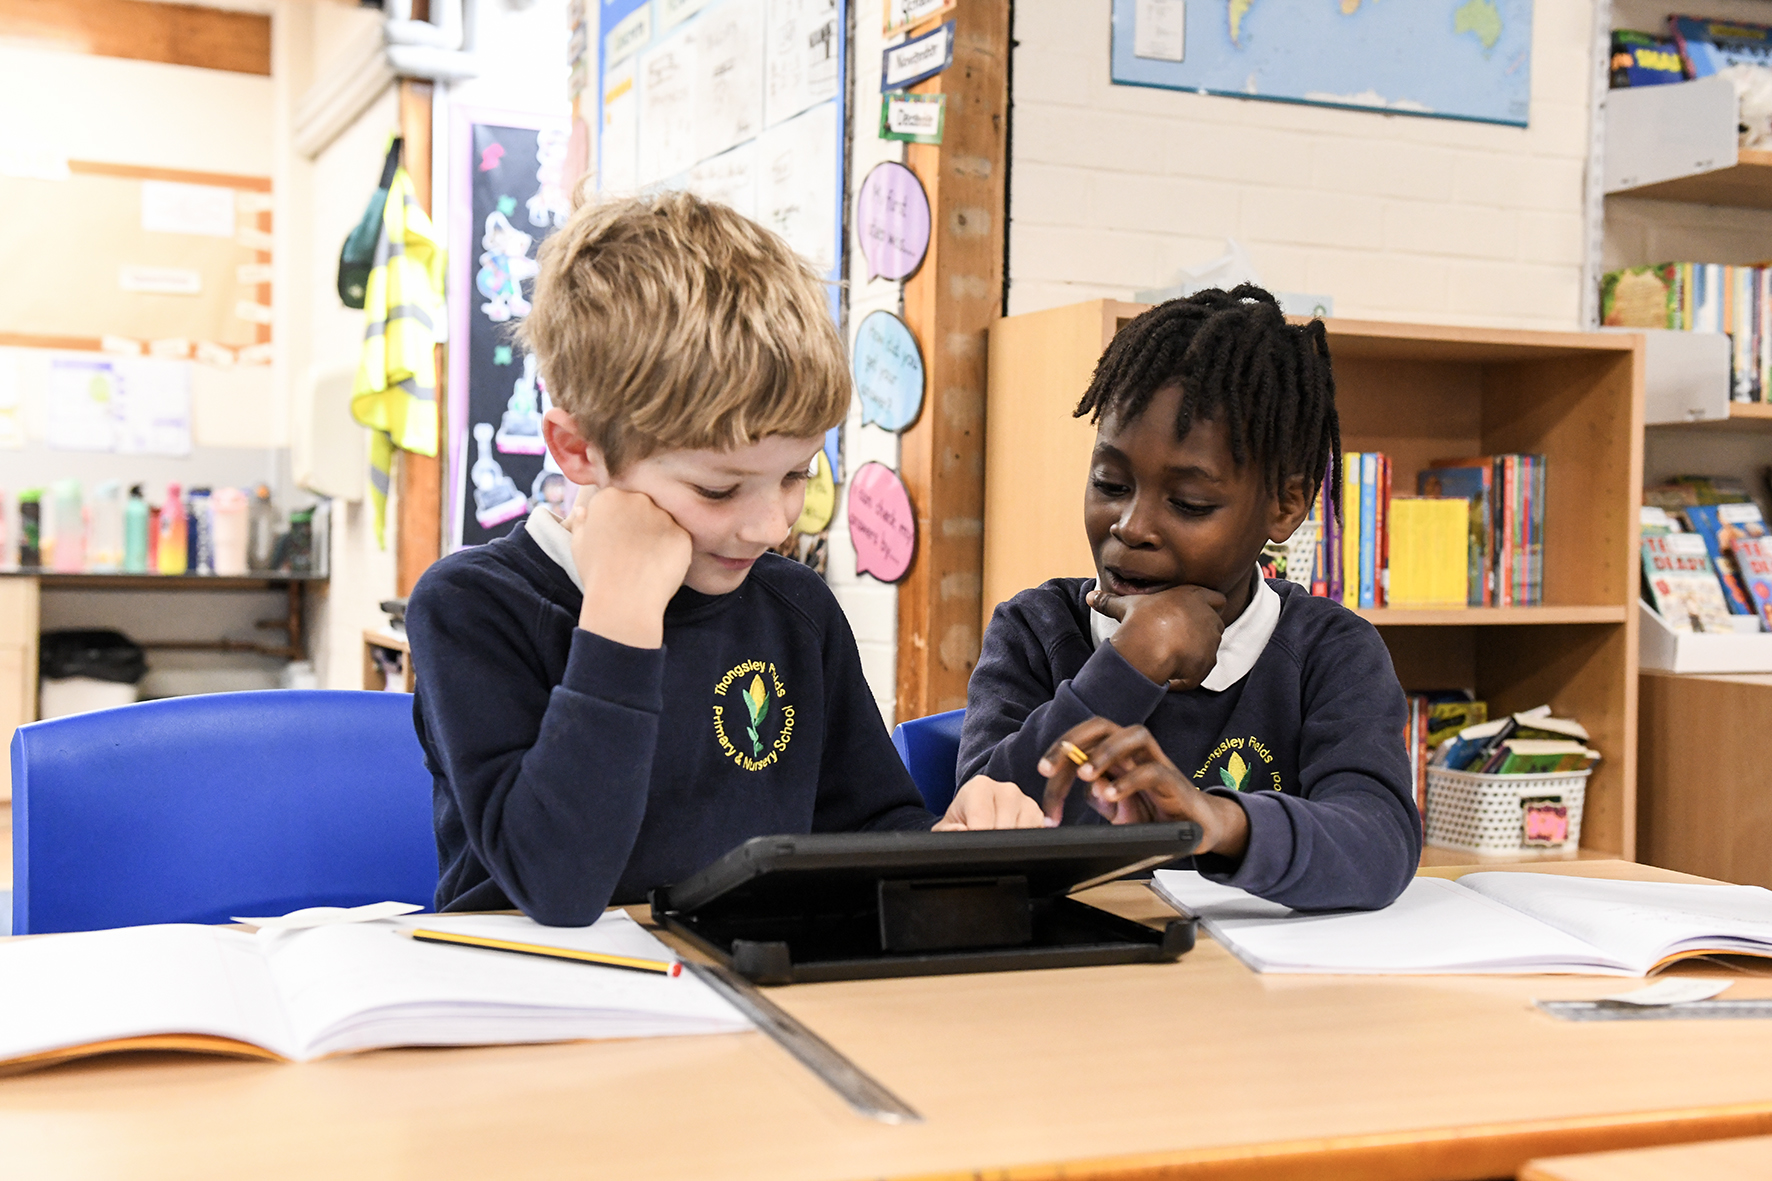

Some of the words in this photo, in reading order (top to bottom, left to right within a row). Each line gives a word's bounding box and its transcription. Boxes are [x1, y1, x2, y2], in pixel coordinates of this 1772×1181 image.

[714, 658, 766, 697] Thongsley
[712, 705, 737, 757] Primary
[734, 751, 744, 766] &
[742, 750, 778, 772] Nursery
[773, 705, 796, 752] School
[1192, 737, 1245, 779] Thongsley
